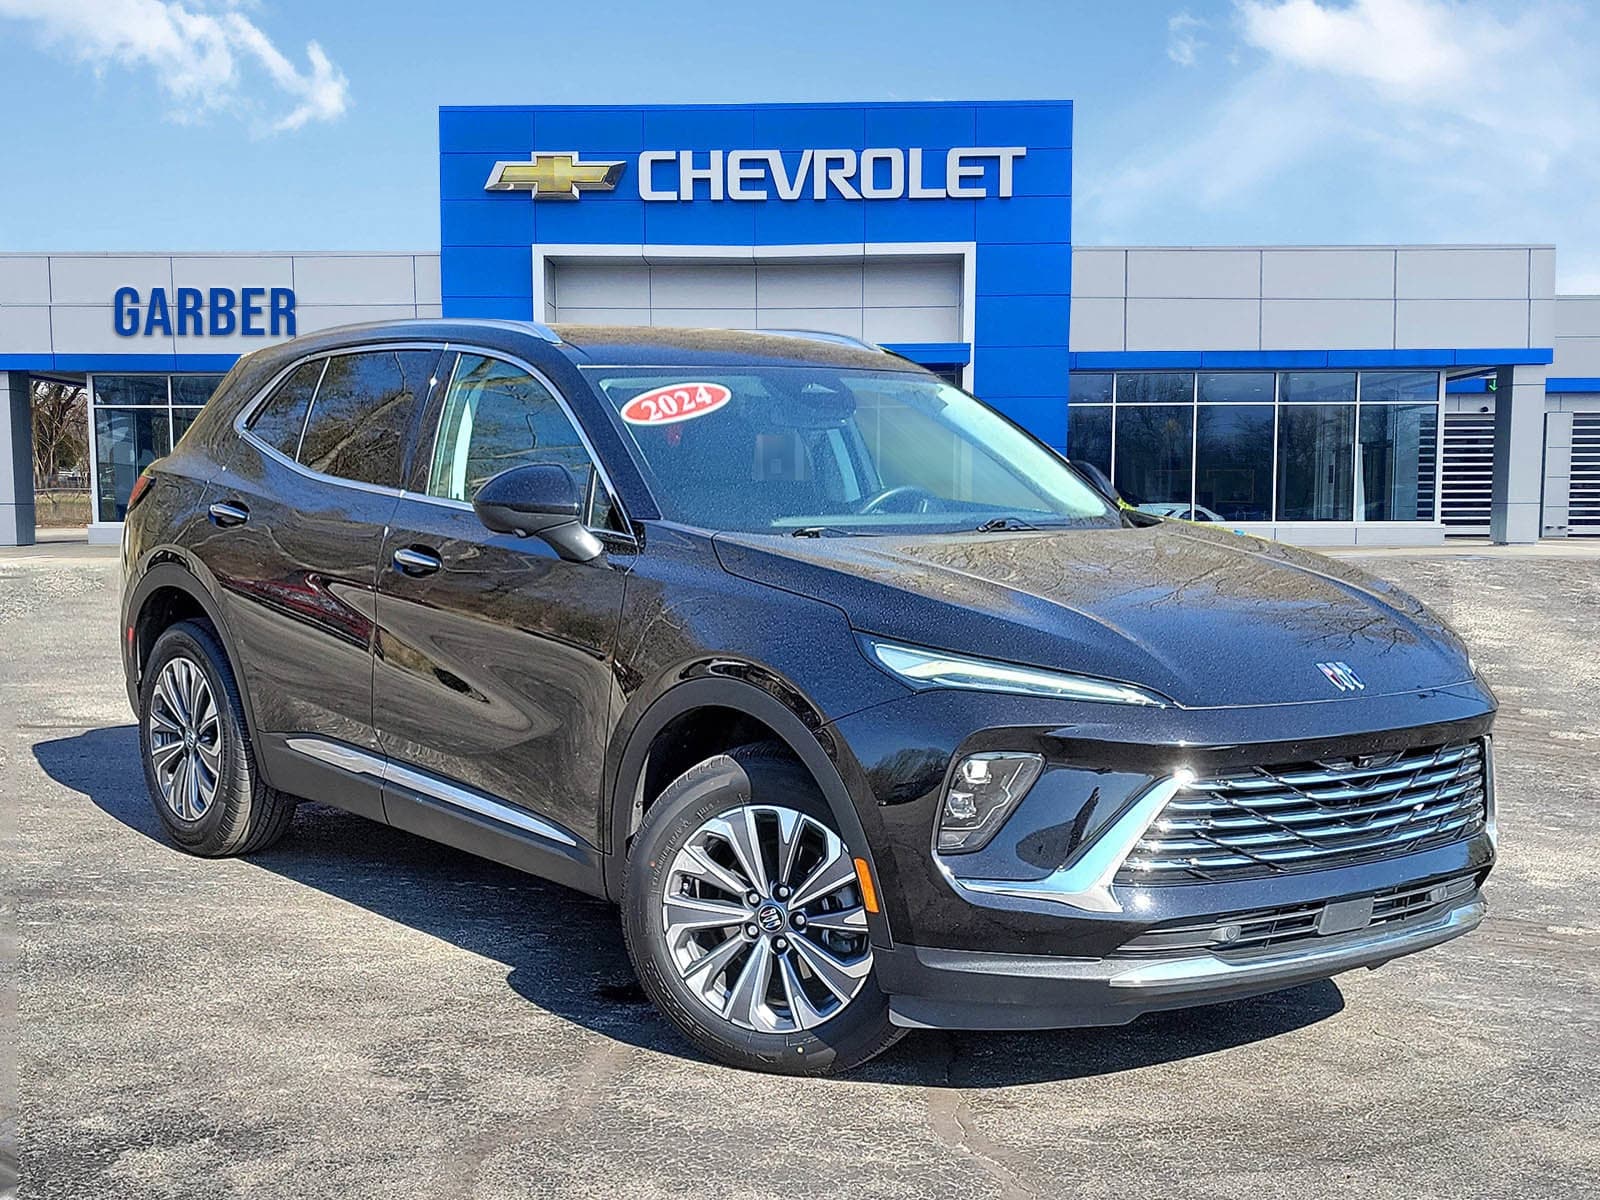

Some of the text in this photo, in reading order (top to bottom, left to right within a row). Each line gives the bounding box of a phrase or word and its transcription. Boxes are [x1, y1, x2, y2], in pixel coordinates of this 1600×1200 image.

[638, 146, 1027, 201] CHEVROLET
[114, 286, 296, 337] GARBER
[641, 386, 712, 420] 2024
